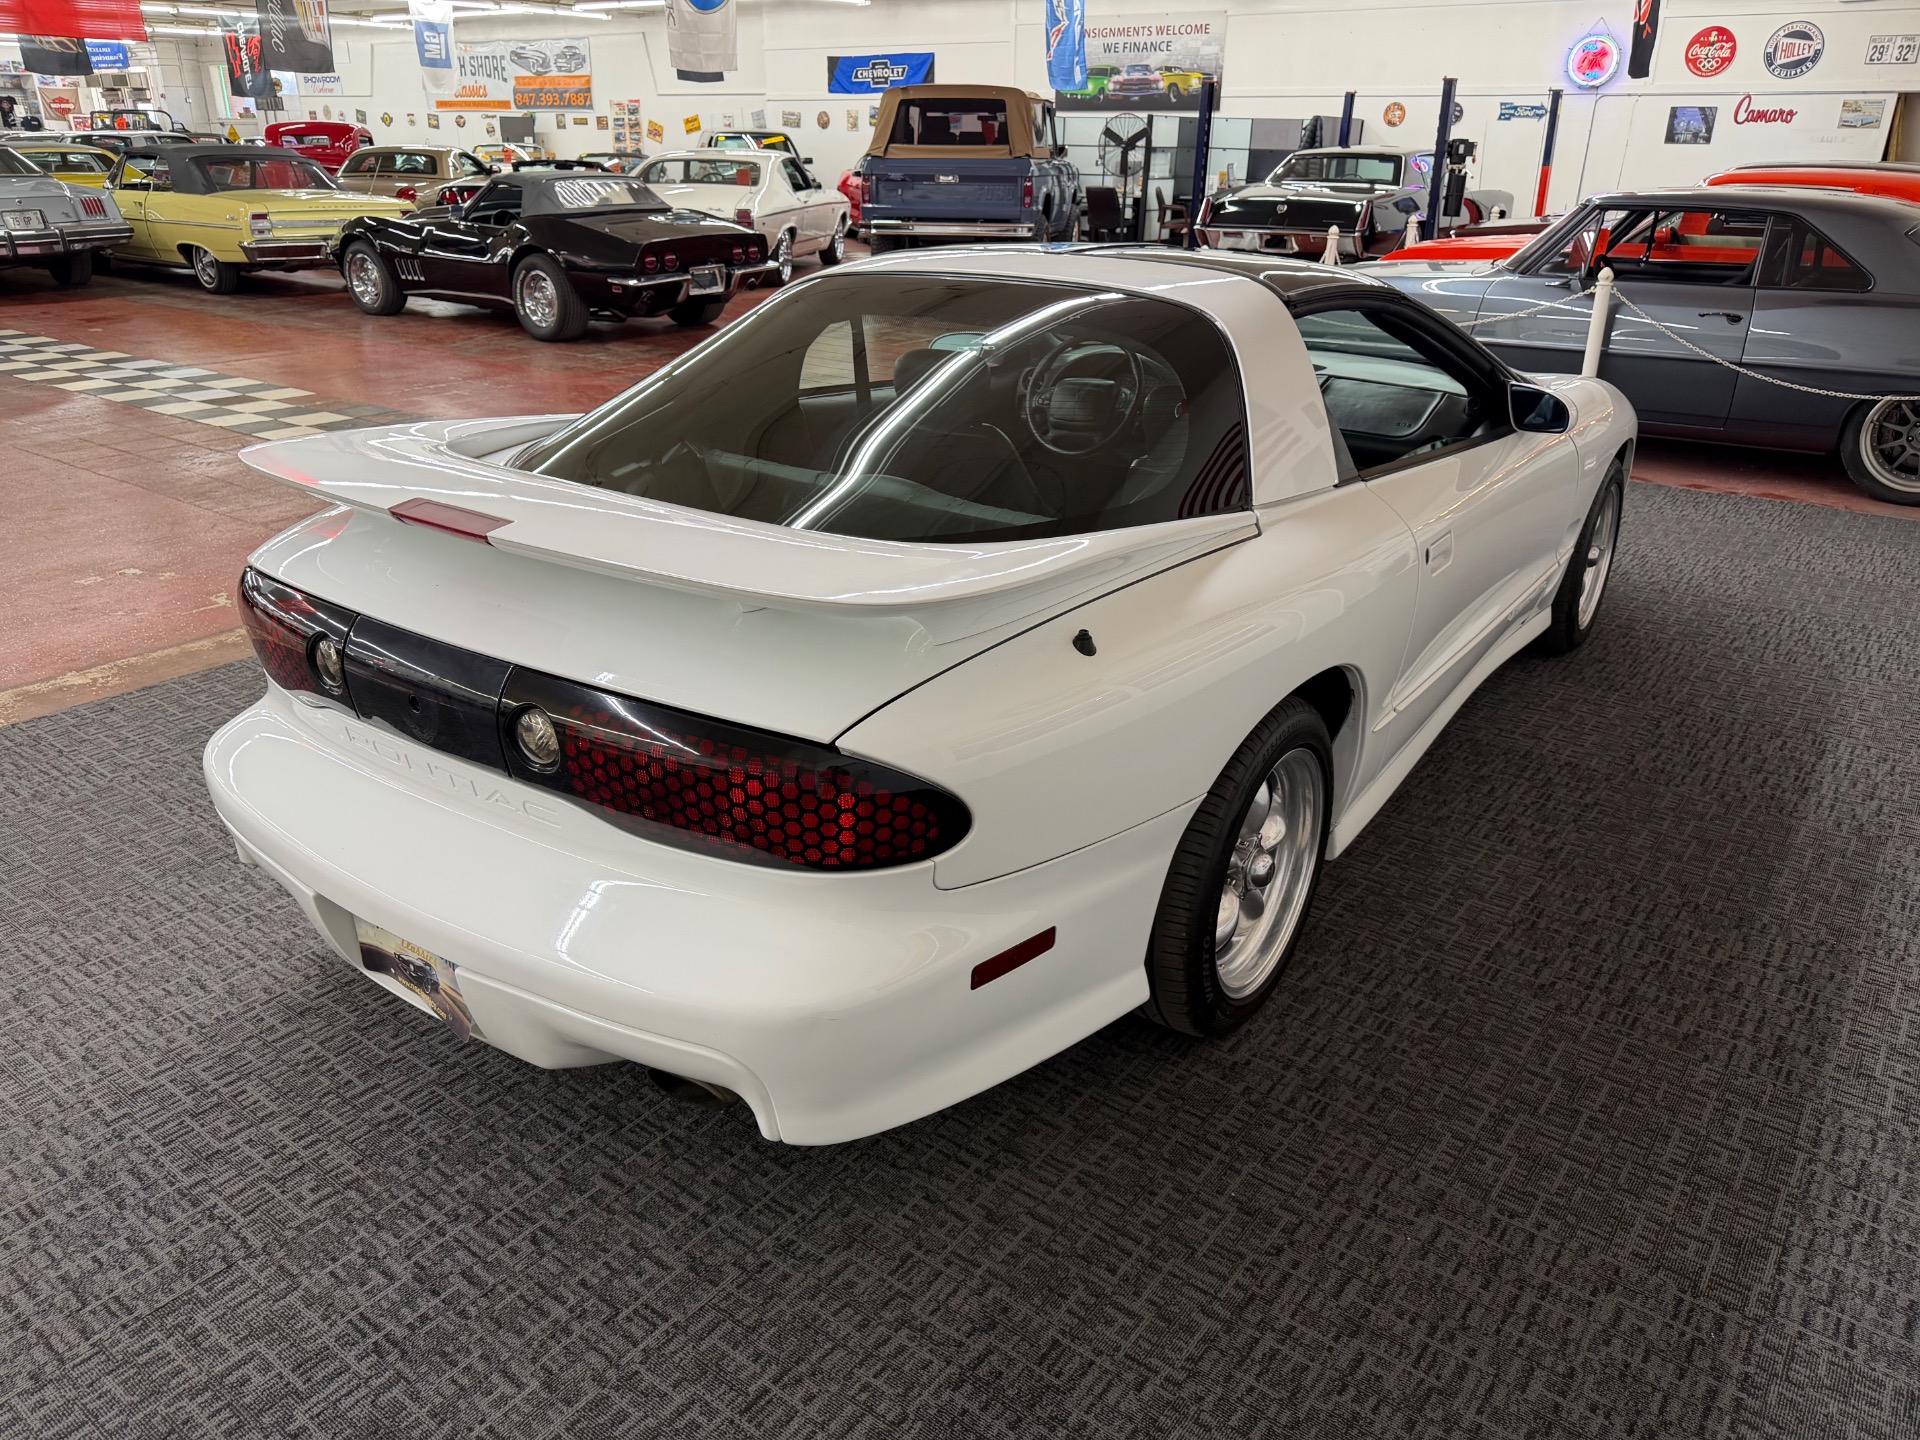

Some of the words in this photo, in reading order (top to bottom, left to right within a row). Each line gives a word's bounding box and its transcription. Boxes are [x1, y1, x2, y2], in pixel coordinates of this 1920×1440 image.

[1084, 26, 1152, 39] NSIGNMENTS
[1155, 23, 1211, 36] WELCOME
[1768, 33, 1781, 49] HIGH
[1783, 24, 1822, 46] PERFORMANCE
[1103, 42, 1120, 54] WE
[1122, 41, 1172, 53] FINANCE
[1779, 42, 1813, 60] HOLLEY
[469, 54, 507, 83] SHORE
[857, 67, 904, 79] CHEVROLET
[1770, 61, 1813, 78] EQUIPPED
[303, 76, 340, 84] SHOWROOM
[515, 92, 592, 107] 847.393.7887
[1514, 106, 1537, 117] Ford
[1733, 93, 1798, 125] Camaro
[344, 726, 562, 829] PONTIAC
